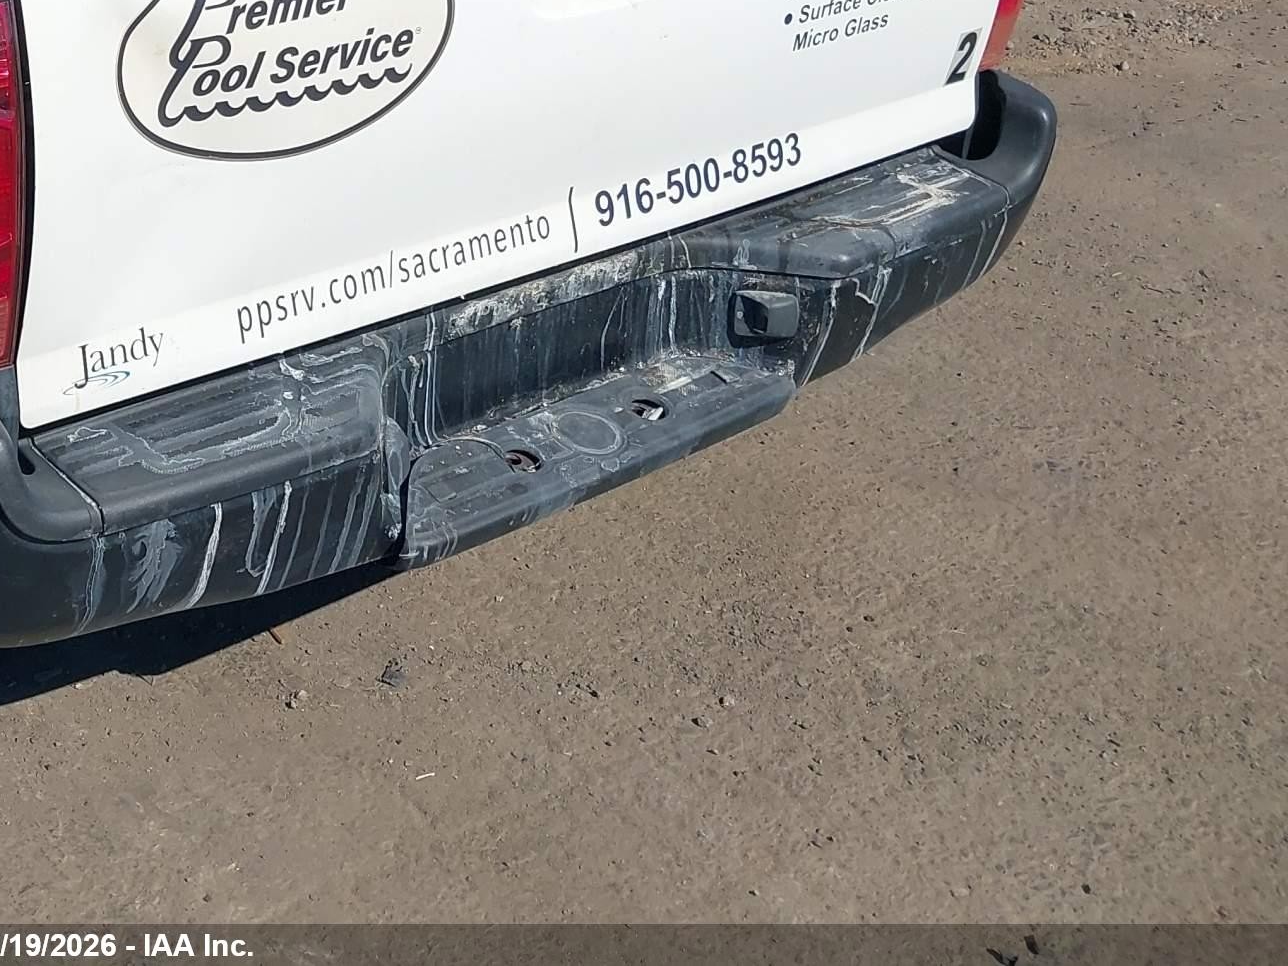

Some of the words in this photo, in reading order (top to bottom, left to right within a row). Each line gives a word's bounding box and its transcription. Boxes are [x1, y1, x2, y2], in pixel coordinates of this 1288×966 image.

[792, 26, 839, 52] Micro
[844, 13, 889, 38] Glass
[944, 31, 978, 85] 2
[158, 35, 266, 127] Pool
[270, 27, 415, 85] Service
[237, 214, 550, 344] ppsrv.com/sacramento
[594, 132, 801, 227] 916-500-8593
[73, 327, 164, 389] Jandy
